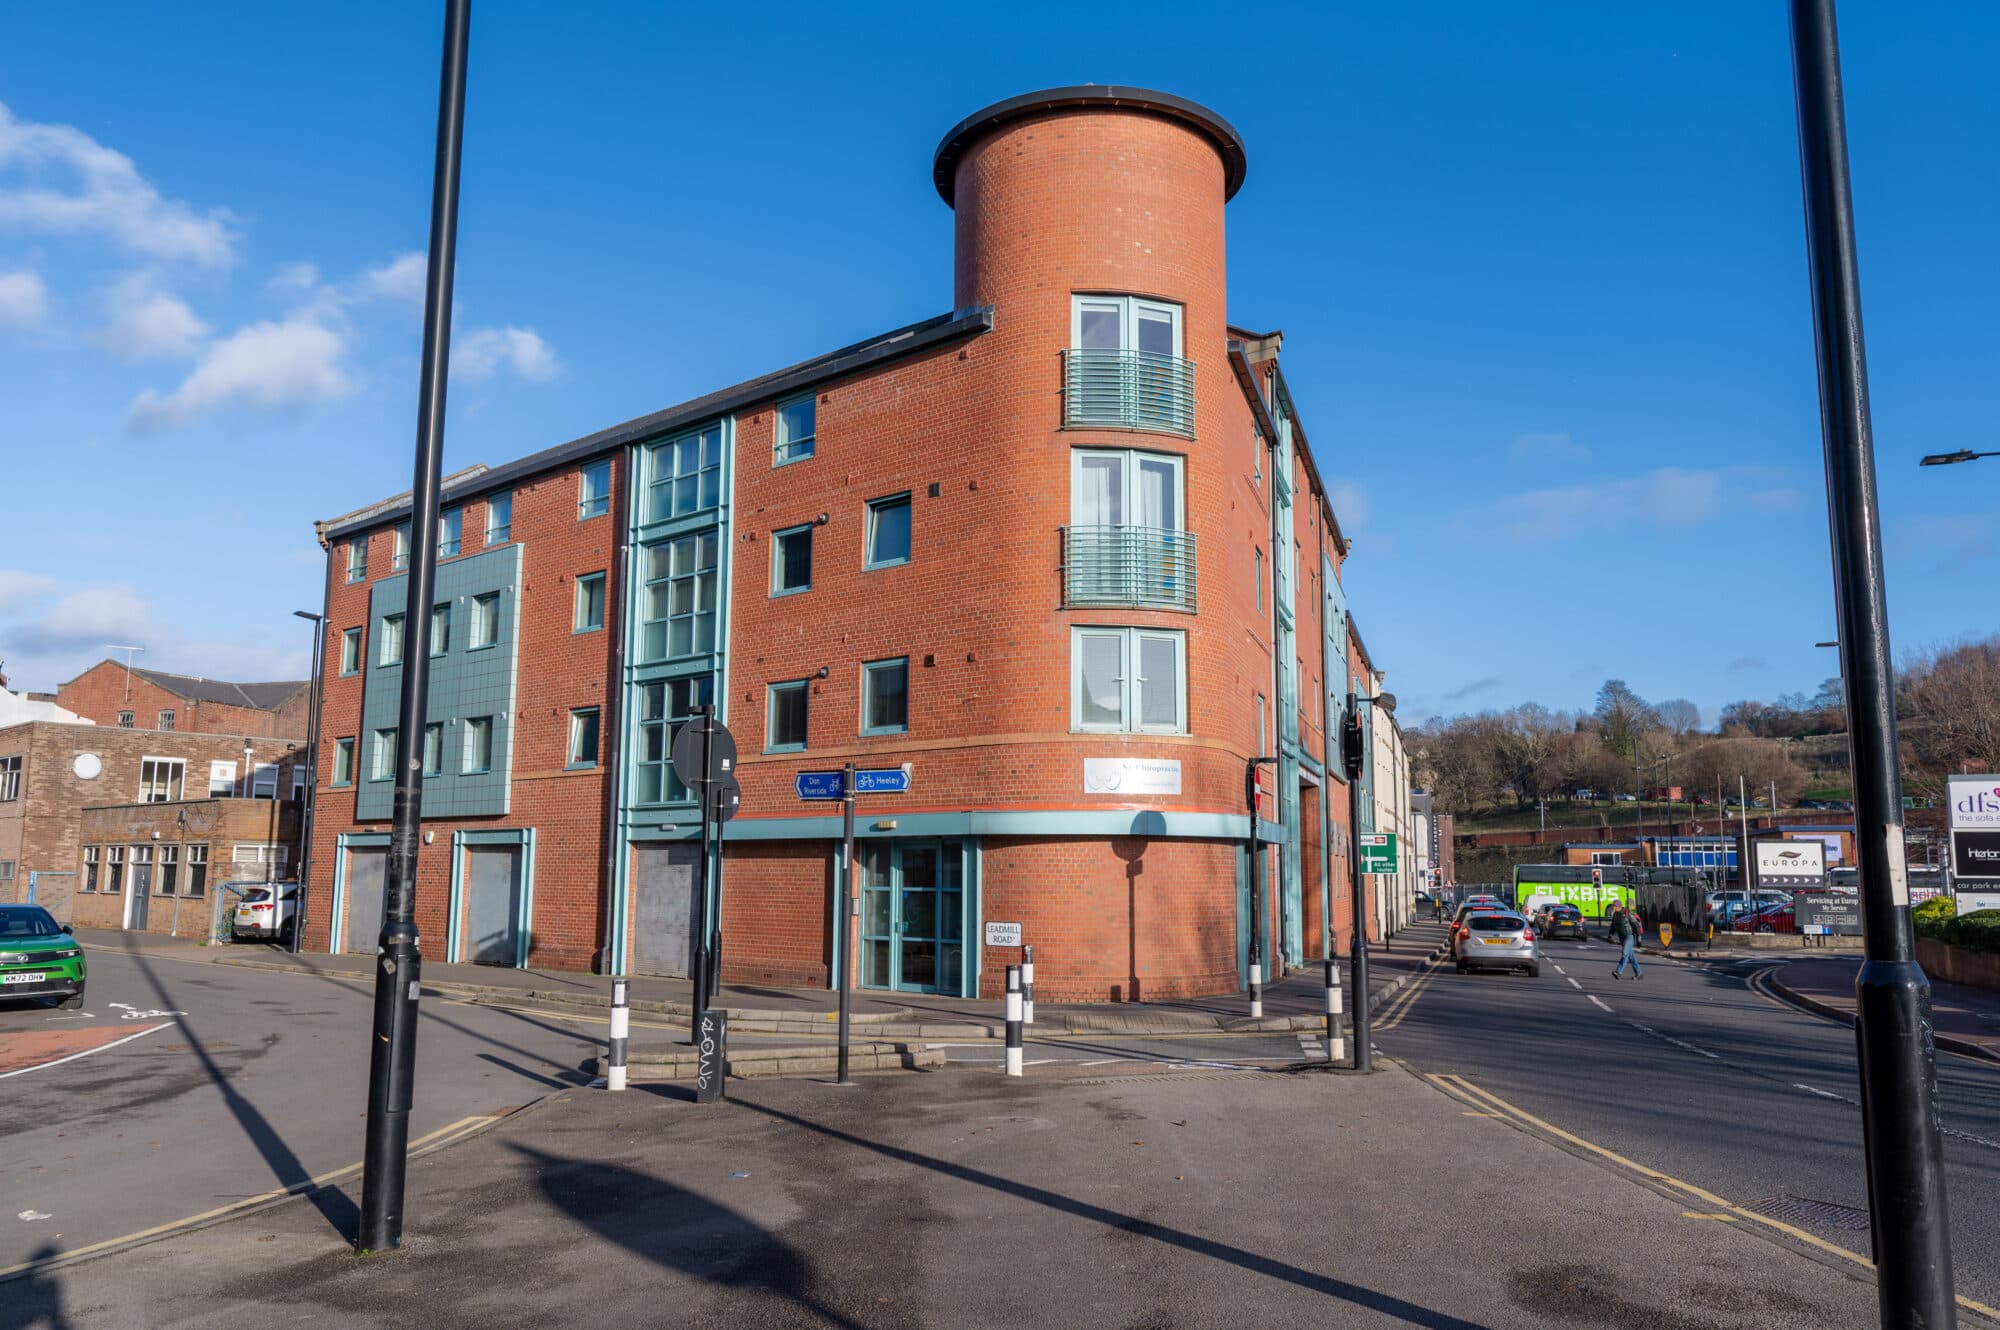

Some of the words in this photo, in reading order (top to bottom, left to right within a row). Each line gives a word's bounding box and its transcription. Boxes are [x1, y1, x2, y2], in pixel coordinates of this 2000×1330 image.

[809, 777, 820, 785] Don
[876, 776, 900, 786] Heeley
[804, 786, 827, 795] Riverside
[1958, 792, 1999, 813] dfs
[1972, 882, 1991, 890] park
[1807, 896, 1833, 905] Servicing
[987, 924, 1019, 934] LEADMILL
[993, 935, 1014, 944] ROAD
